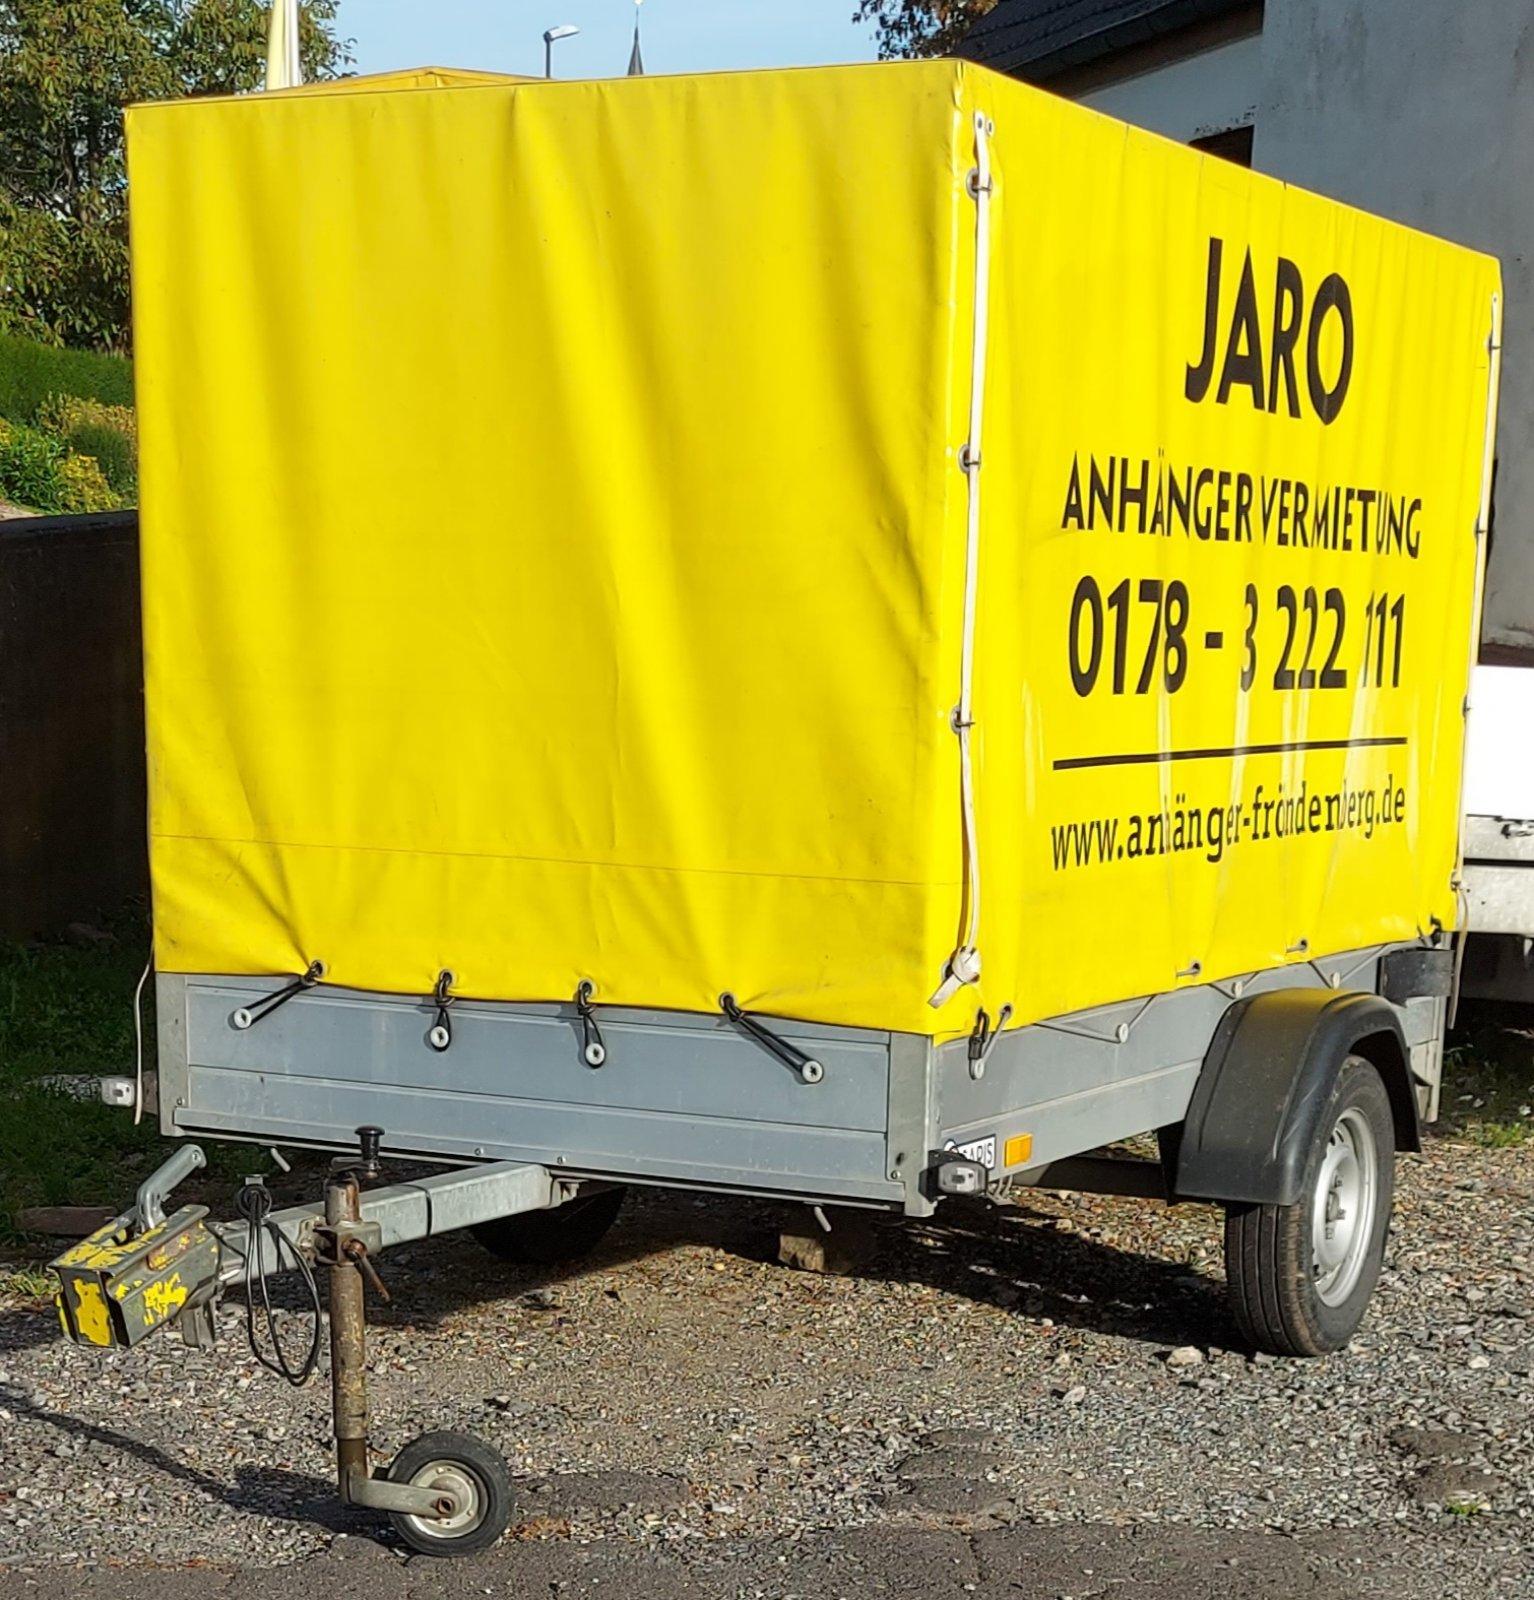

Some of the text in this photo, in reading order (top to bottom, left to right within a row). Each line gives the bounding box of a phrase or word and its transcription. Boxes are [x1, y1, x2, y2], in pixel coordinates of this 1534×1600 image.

[1185, 237, 1354, 425] JARO
[1069, 575, 1405, 697] 0178 - 3 222 111
